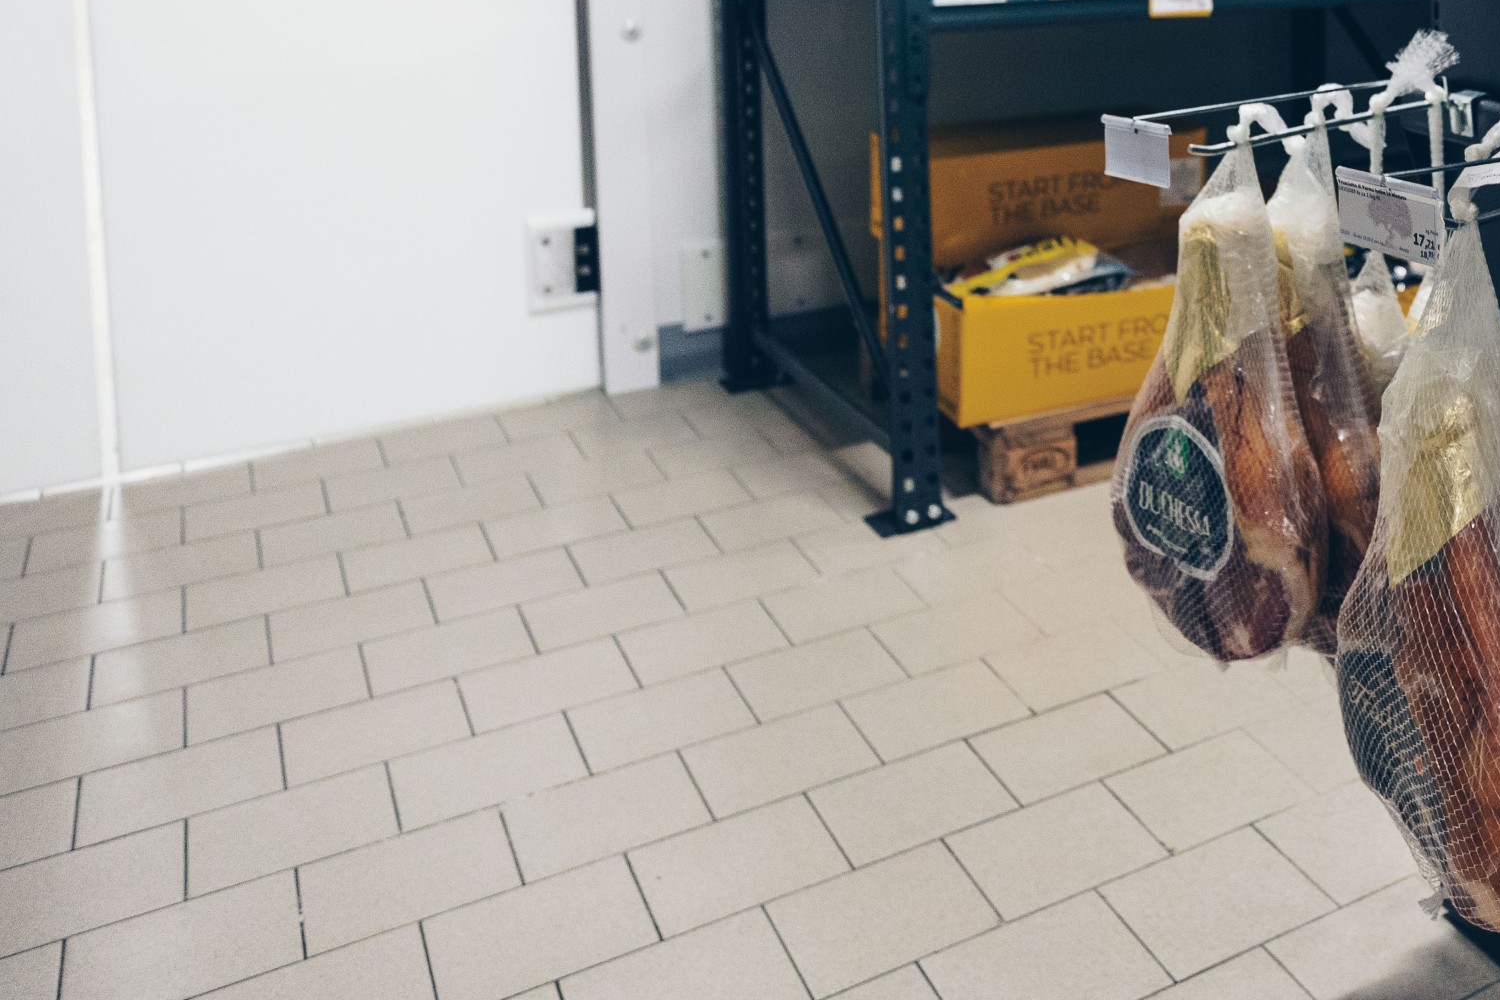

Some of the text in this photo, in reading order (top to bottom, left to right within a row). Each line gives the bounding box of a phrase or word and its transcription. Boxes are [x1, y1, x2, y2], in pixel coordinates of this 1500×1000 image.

[988, 171, 1117, 199] START FRO
[992, 196, 1098, 225] THE BASE
[1413, 232, 1435, 251] 17,71
[1028, 313, 1170, 353] START FRO
[1030, 351, 1081, 378] THE
[1138, 480, 1210, 536] DUCHESSA
